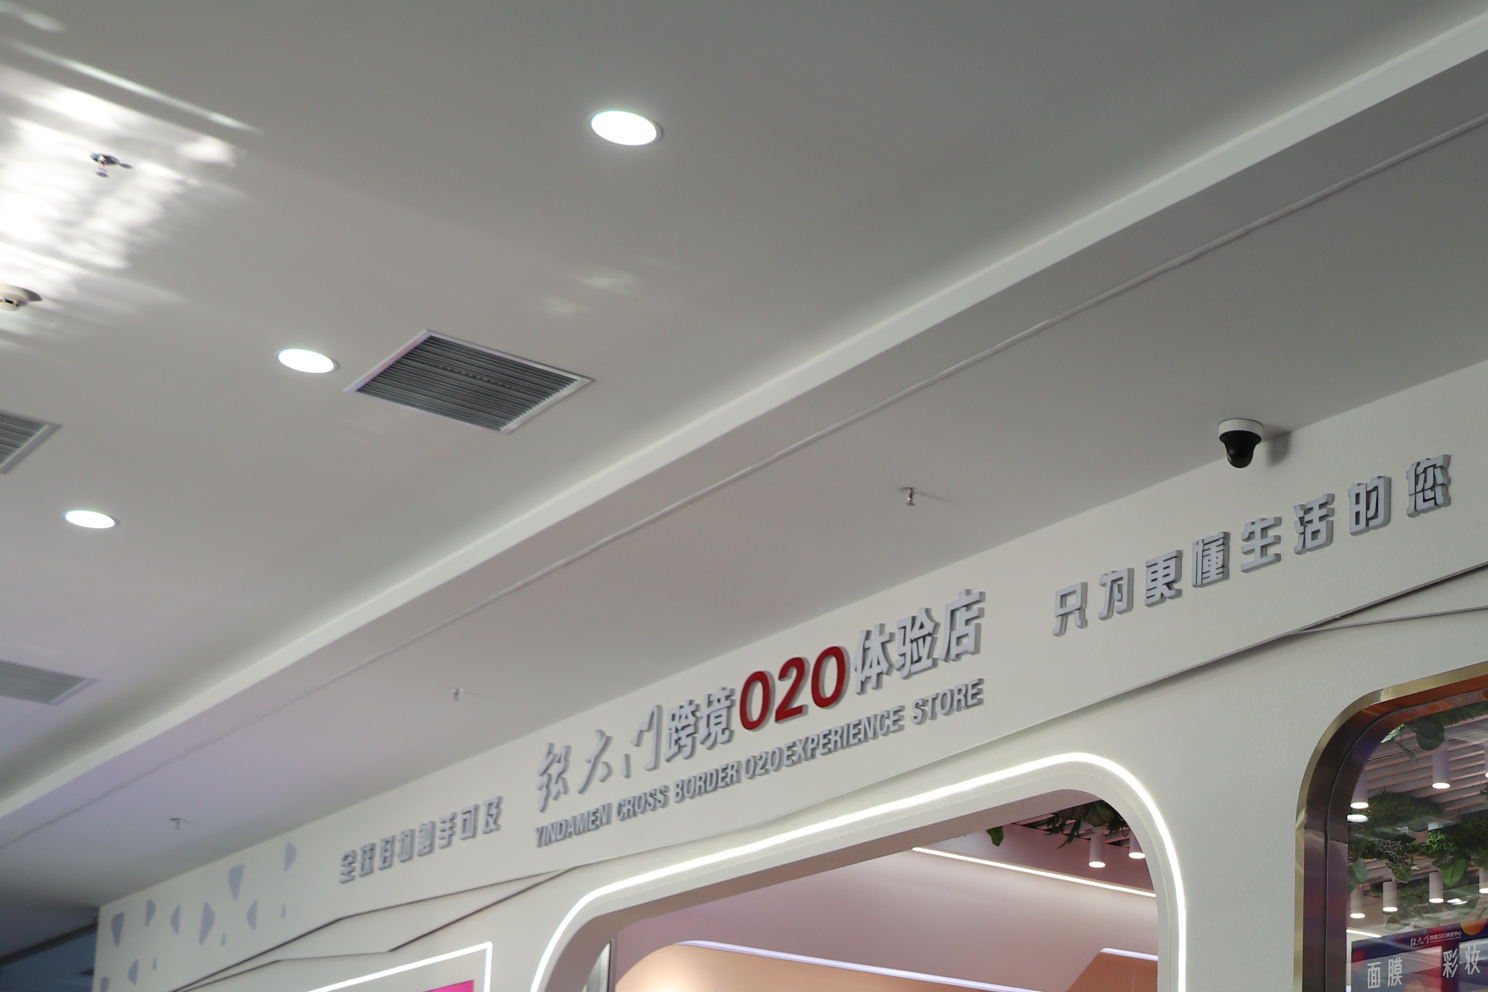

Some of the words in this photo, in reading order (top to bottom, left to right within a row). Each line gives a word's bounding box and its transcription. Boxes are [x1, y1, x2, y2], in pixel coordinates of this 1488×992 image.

[1052, 454, 1452, 638] 只为更懂生活的您
[535, 802, 613, 848] YINDAMEN
[615, 785, 670, 822] CROSS
[673, 760, 744, 803] BORDER
[781, 704, 905, 767] EXPERIENCE
[910, 677, 985, 726] STORE
[1367, 956, 1403, 989] 面膜
[1442, 944, 1481, 978] 彩妆
